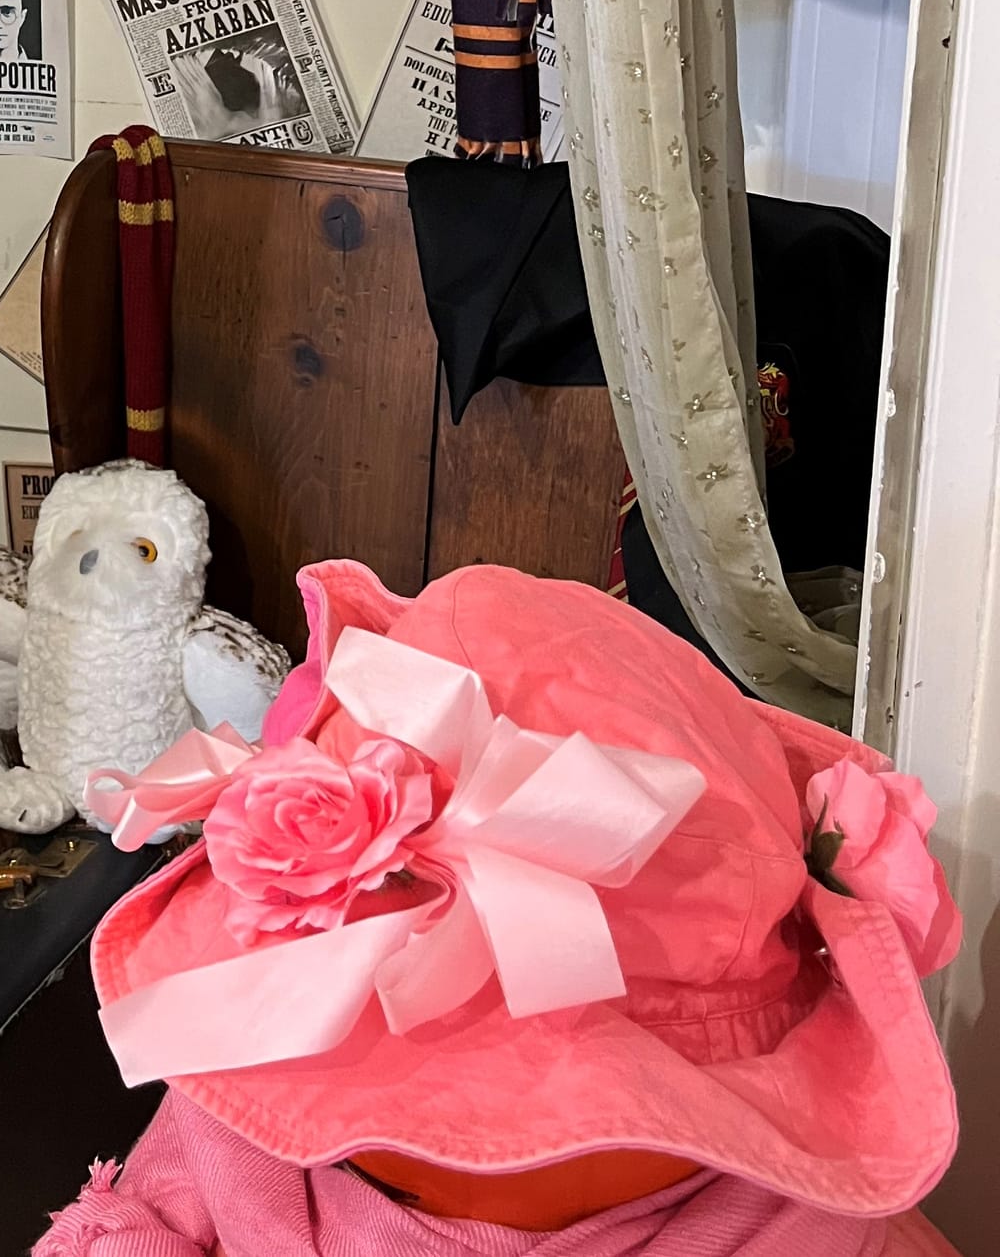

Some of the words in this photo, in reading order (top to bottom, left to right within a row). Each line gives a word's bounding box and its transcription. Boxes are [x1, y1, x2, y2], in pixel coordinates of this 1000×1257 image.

[411, 77, 455, 103] HAS
[417, 97, 457, 120] APPO
[428, 115, 449, 133] THE
